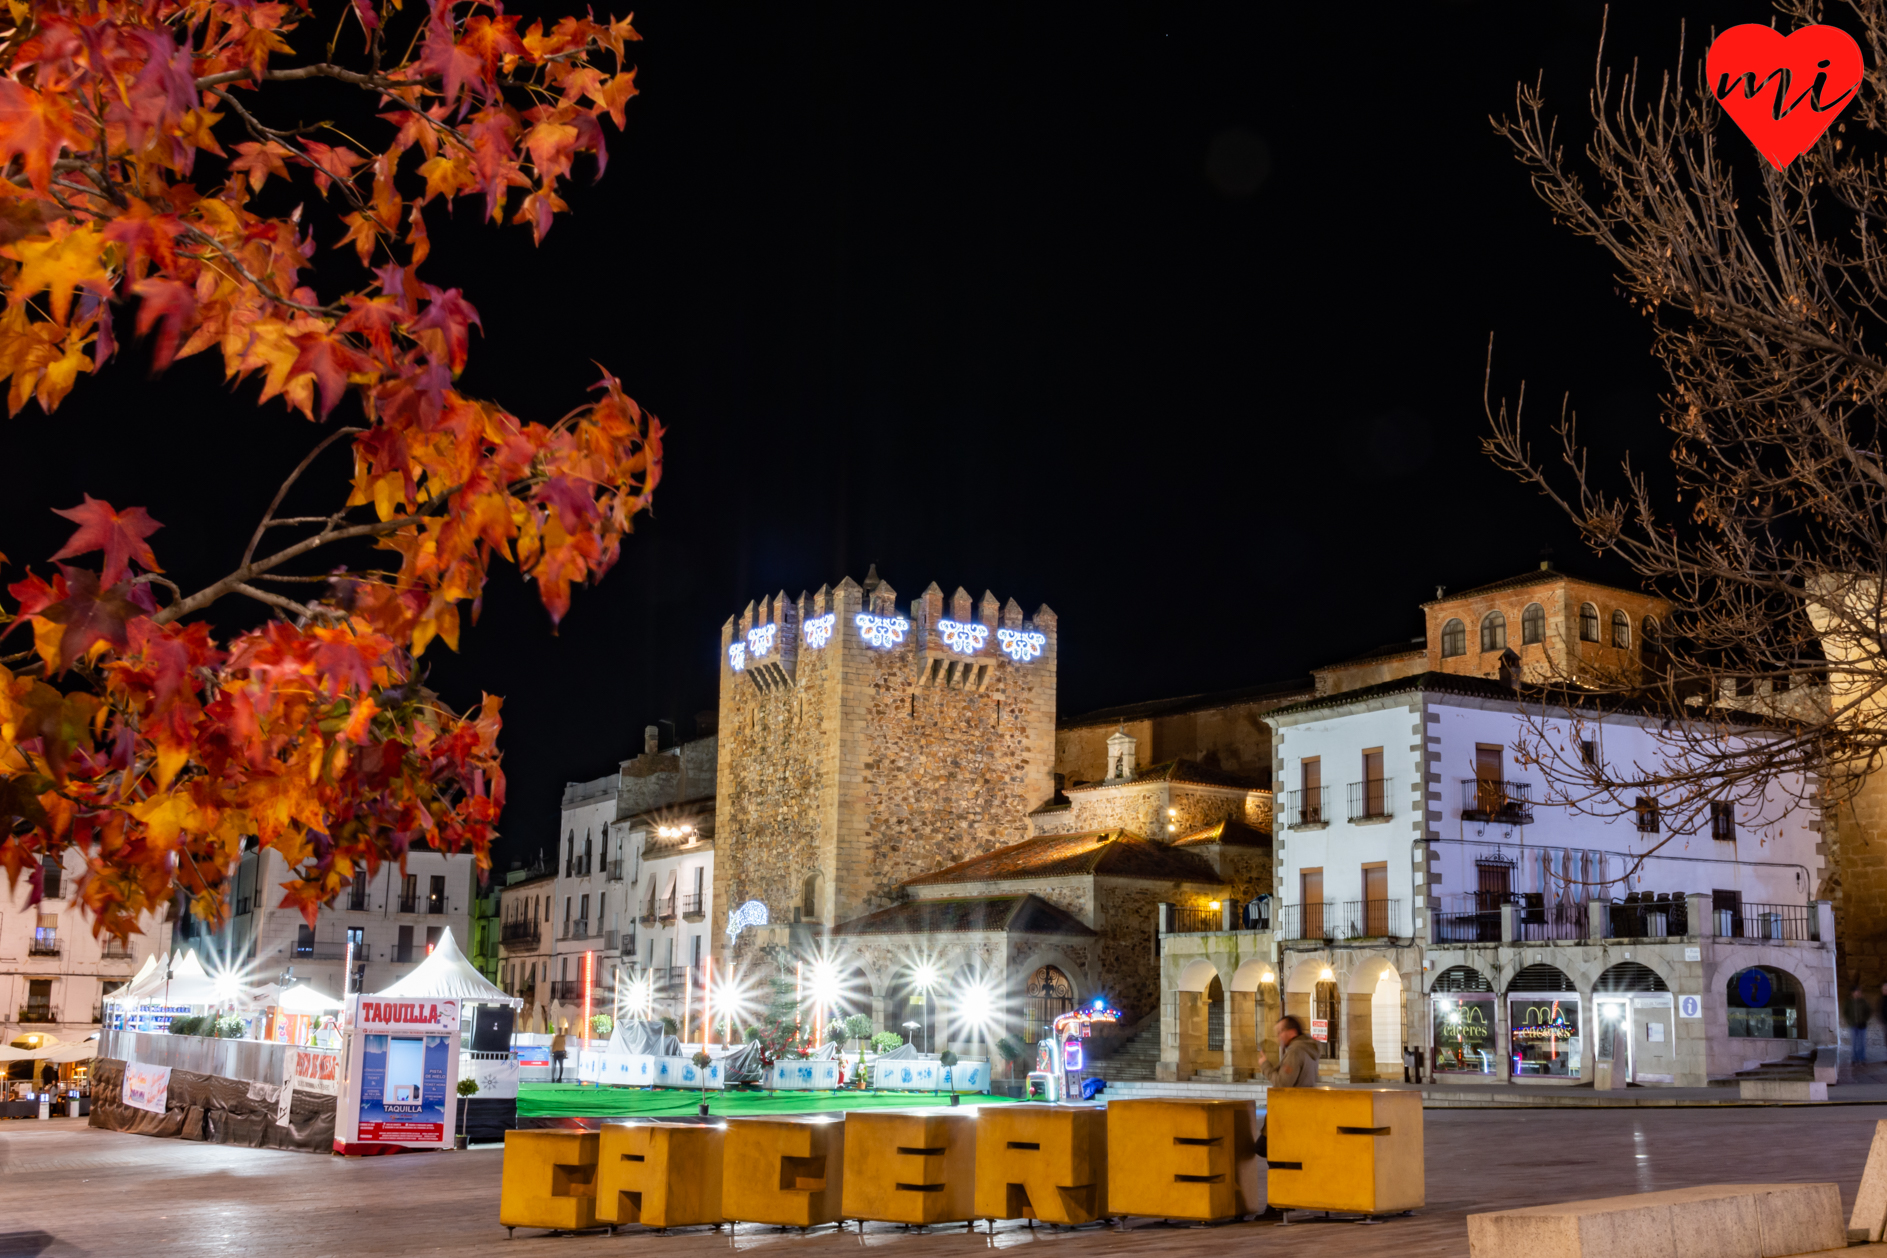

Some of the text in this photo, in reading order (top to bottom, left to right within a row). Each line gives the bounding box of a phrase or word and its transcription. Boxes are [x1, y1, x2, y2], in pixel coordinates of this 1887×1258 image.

[362, 1002, 438, 1025] TAQUILLA
[383, 1105, 423, 1113] TAQUILLA
[500, 1086, 1425, 1227] CACERES
